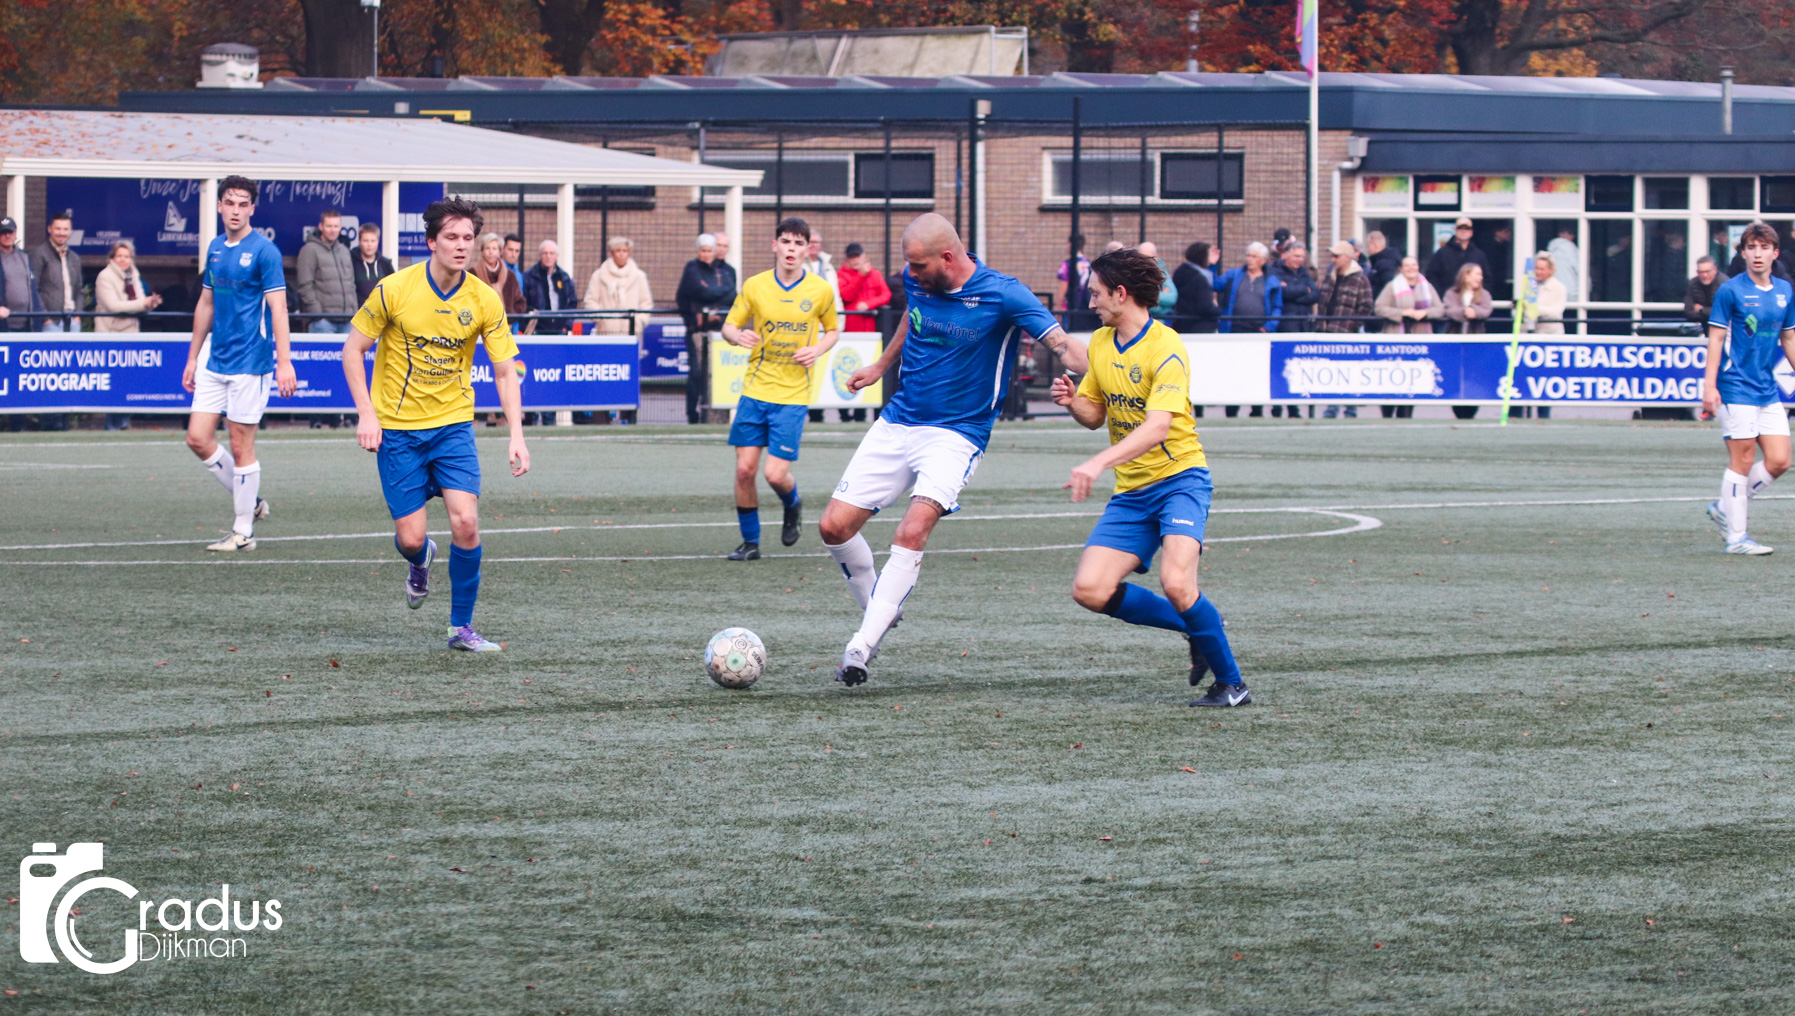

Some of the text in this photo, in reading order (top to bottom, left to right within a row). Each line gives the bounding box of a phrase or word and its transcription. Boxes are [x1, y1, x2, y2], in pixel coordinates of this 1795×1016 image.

[776, 321, 809, 332] PRUIS
[923, 316, 980, 341] Van Norel
[19, 349, 162, 368] GONNY VAN DUINEN
[1376, 345, 1429, 355] KANTOOR
[1505, 345, 1708, 369] VOETBALSCHOO
[18, 373, 111, 391] FOTOGRAFIE
[533, 367, 562, 382] voor
[565, 363, 631, 382] IEDEREEN!
[1300, 367, 1422, 386] NON STOP
